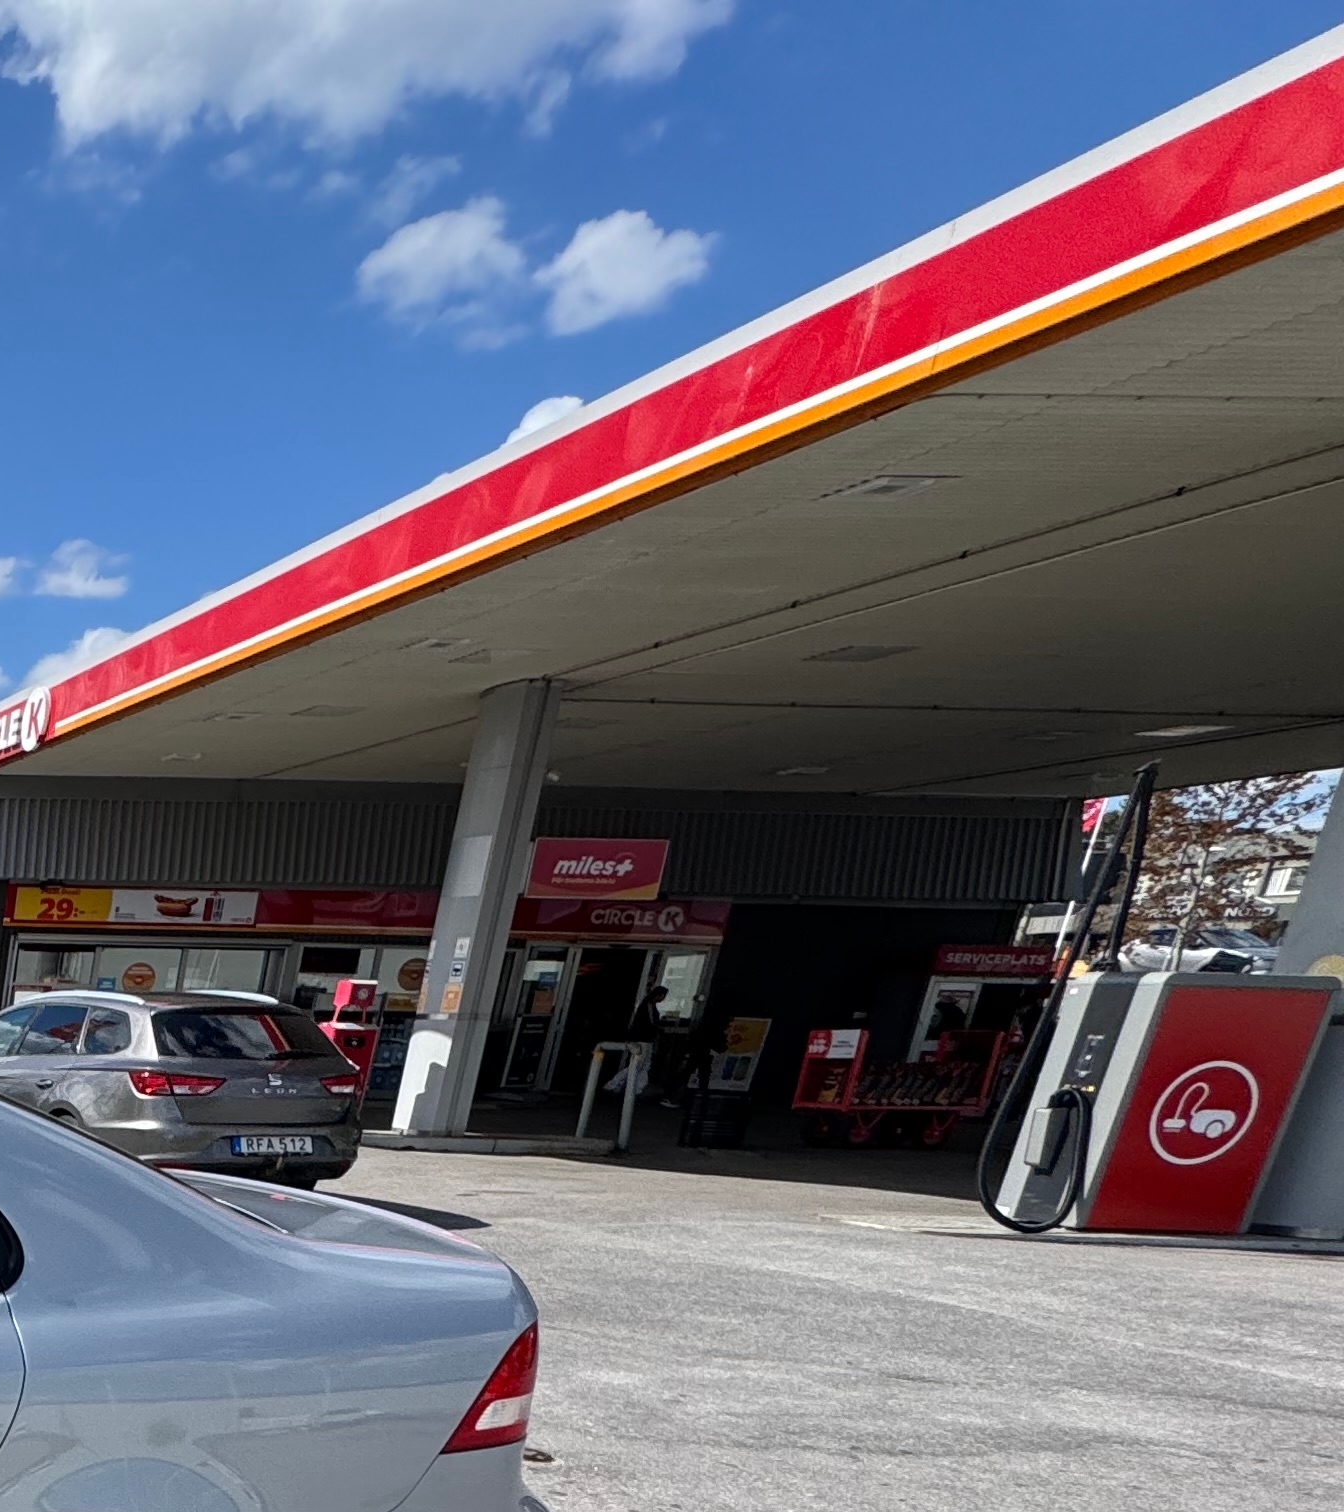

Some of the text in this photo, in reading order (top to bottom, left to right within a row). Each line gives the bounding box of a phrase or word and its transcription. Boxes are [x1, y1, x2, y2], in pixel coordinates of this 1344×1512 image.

[553, 856, 634, 877] miles+
[1224, 906, 1276, 917] NOD
[590, 907, 683, 931] CIRCLE K
[945, 952, 1046, 966] SERVICEPLATS
[246, 1137, 306, 1151] RFA 512
